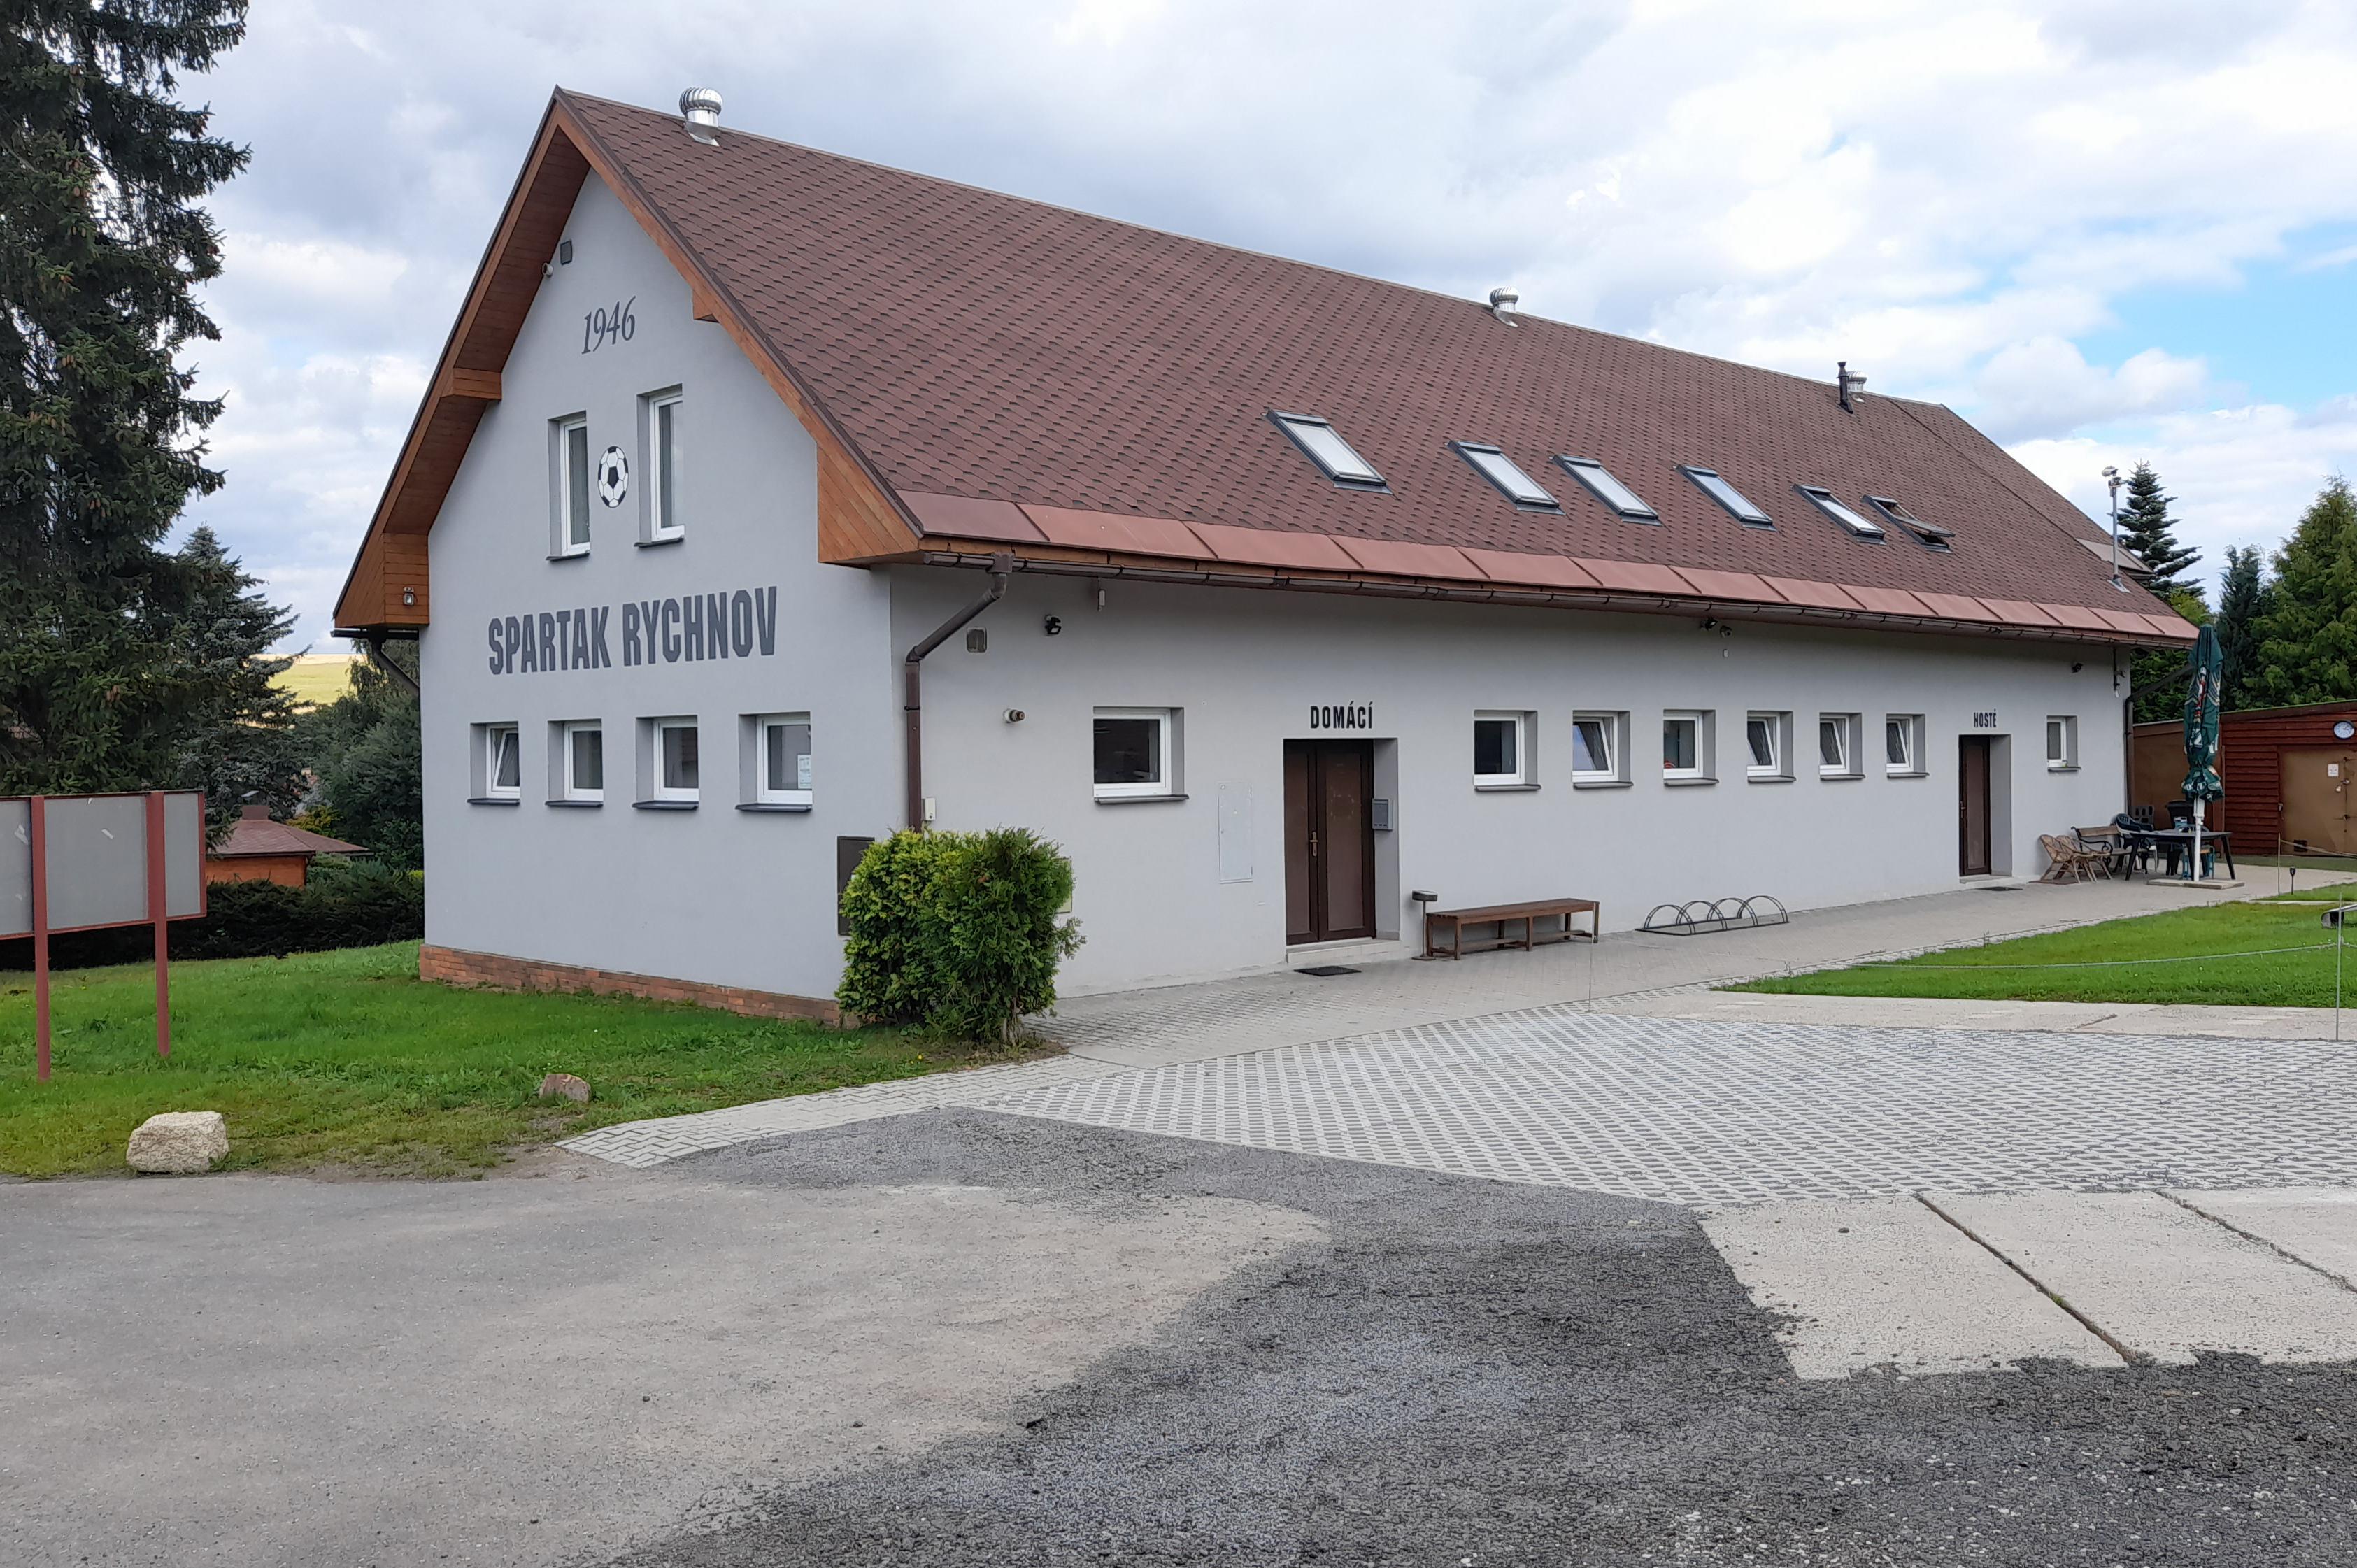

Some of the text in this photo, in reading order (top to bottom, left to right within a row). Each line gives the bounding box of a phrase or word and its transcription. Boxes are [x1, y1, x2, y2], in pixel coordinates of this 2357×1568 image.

[581, 296, 636, 355] 1946
[488, 586, 777, 675] SPARTAK RYCHNOV
[1310, 701, 1373, 729] DOMÁCÍ
[1974, 708, 1997, 728] HOSTÉ
